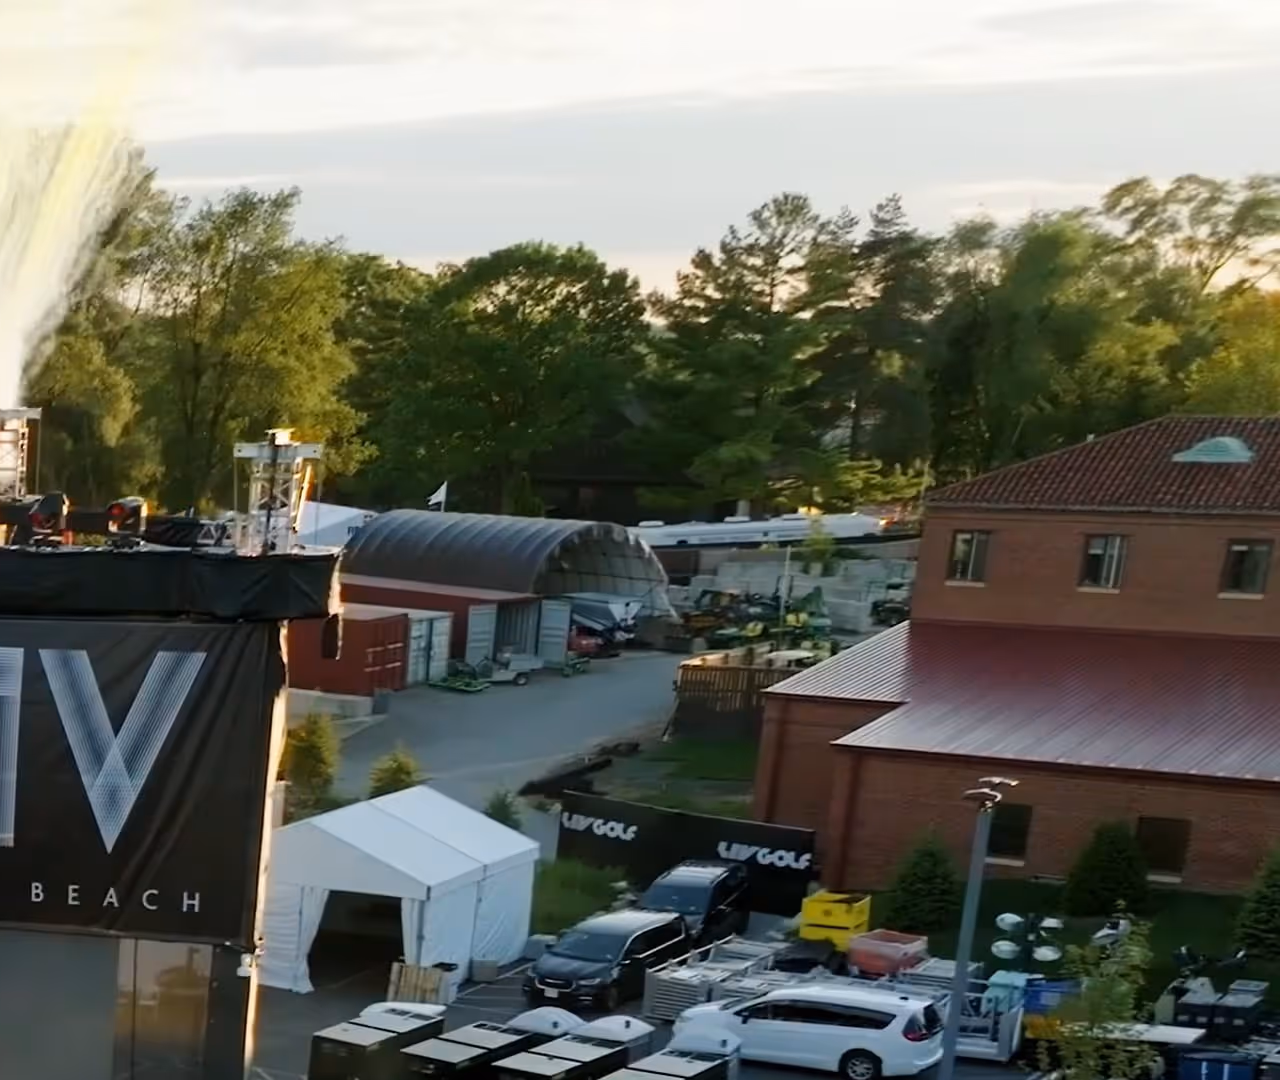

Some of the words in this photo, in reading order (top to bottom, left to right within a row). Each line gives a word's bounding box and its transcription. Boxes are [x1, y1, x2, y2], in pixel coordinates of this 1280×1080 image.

[592, 818, 638, 842] GOLF
[756, 847, 813, 871] GOLF
[30, 882, 201, 914] BEACH
